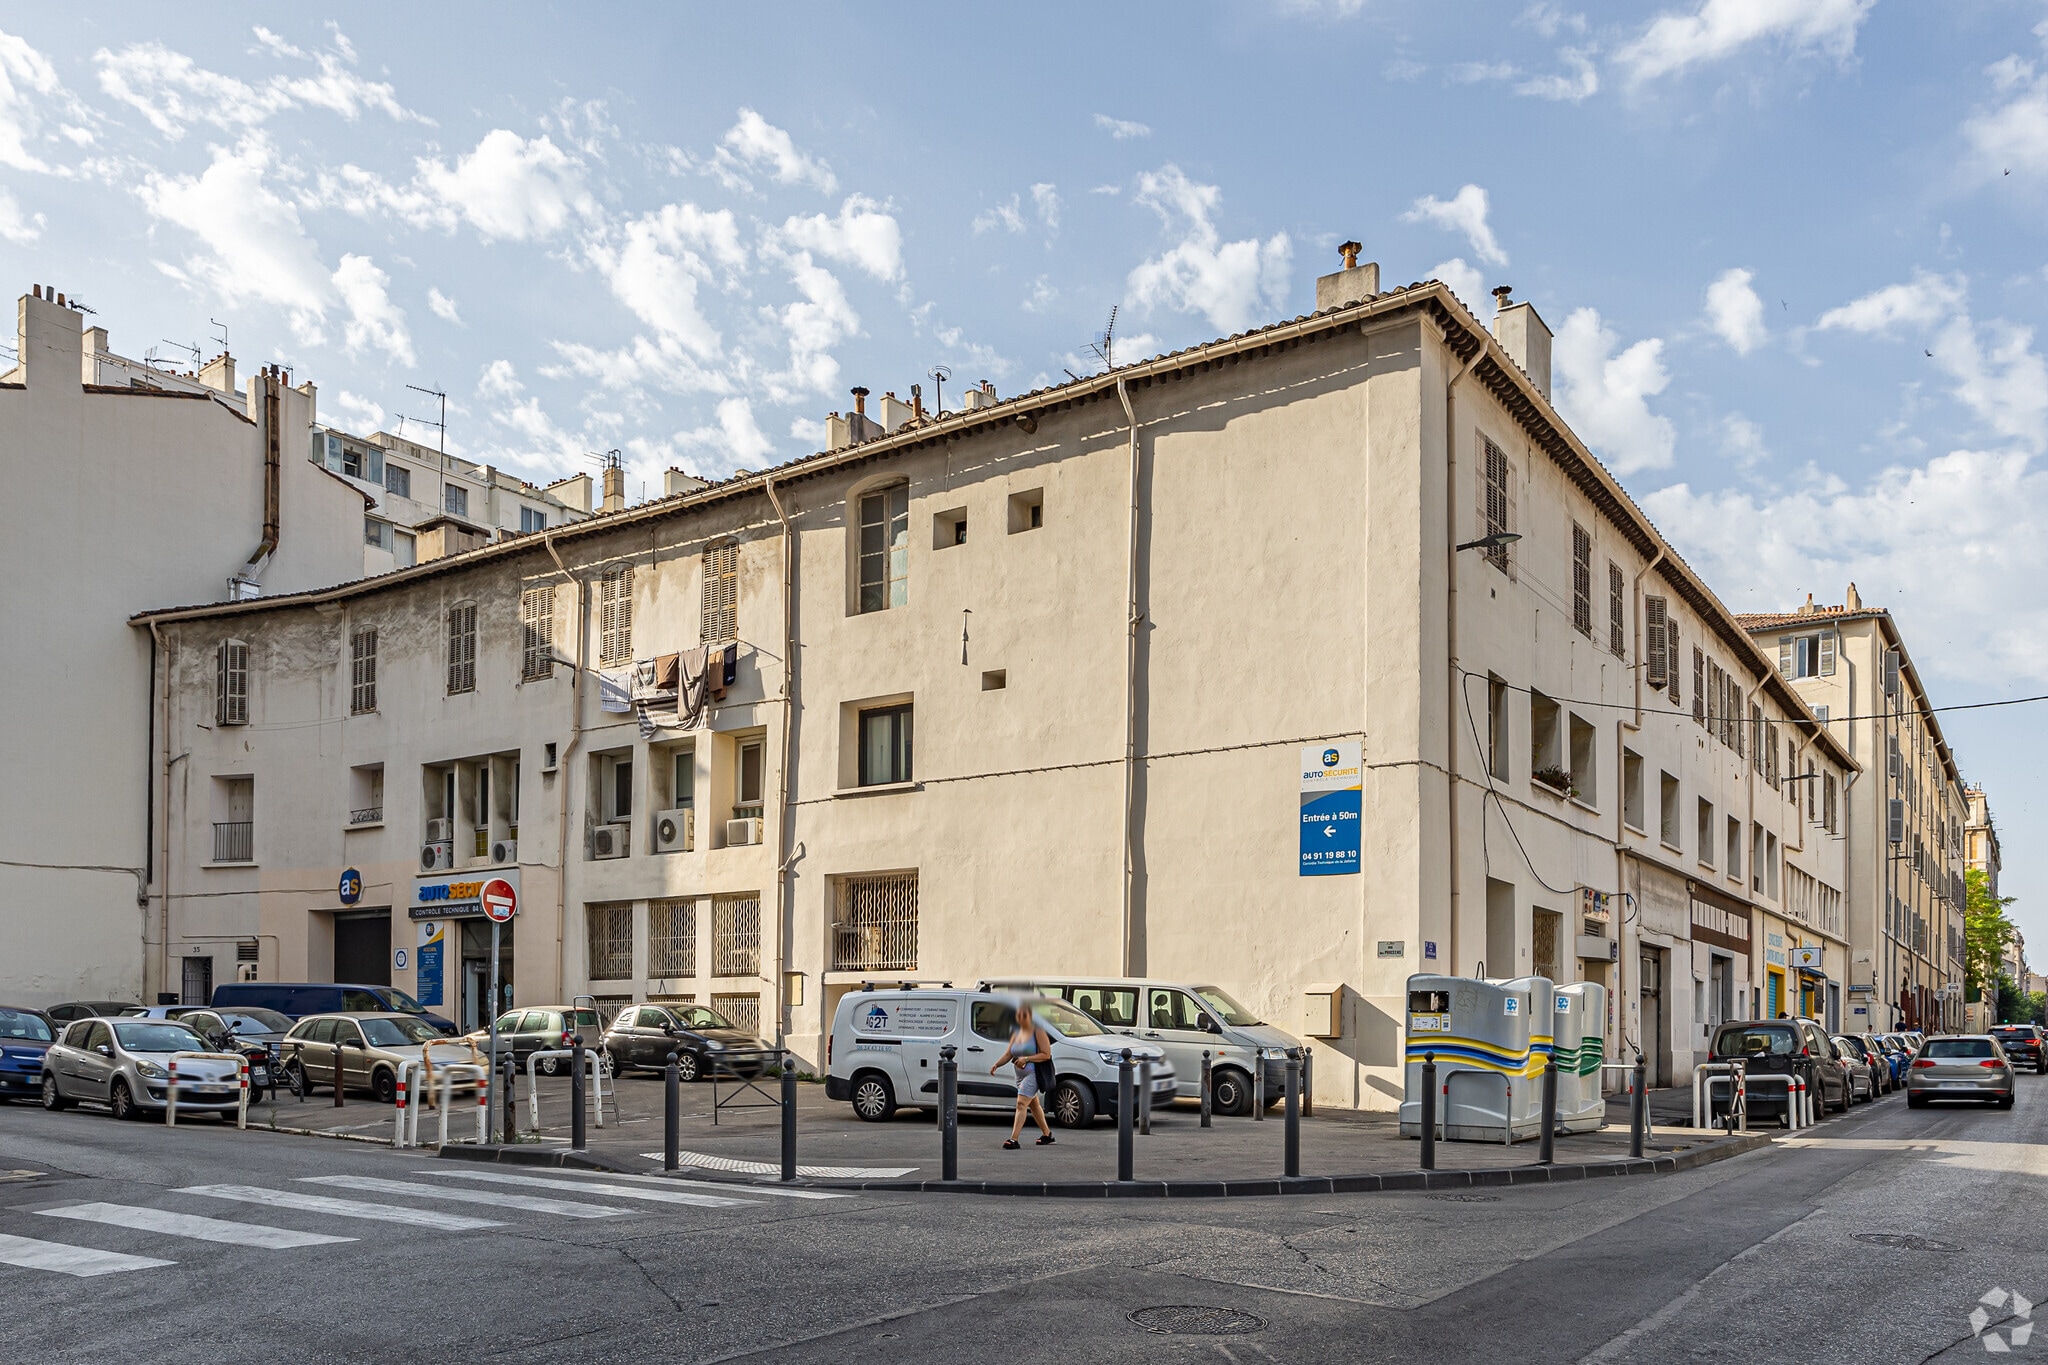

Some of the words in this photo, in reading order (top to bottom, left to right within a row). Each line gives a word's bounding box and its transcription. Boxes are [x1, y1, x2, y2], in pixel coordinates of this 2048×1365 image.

[1303, 812, 1330, 823] Entrée
[1332, 812, 1337, 821] à
[1340, 812, 1358, 820] 50m
[1336, 850, 1345, 859] 88
[1348, 850, 1357, 858] 10
[341, 878, 359, 896] as
[443, 906, 469, 914] TECHNIQUE
